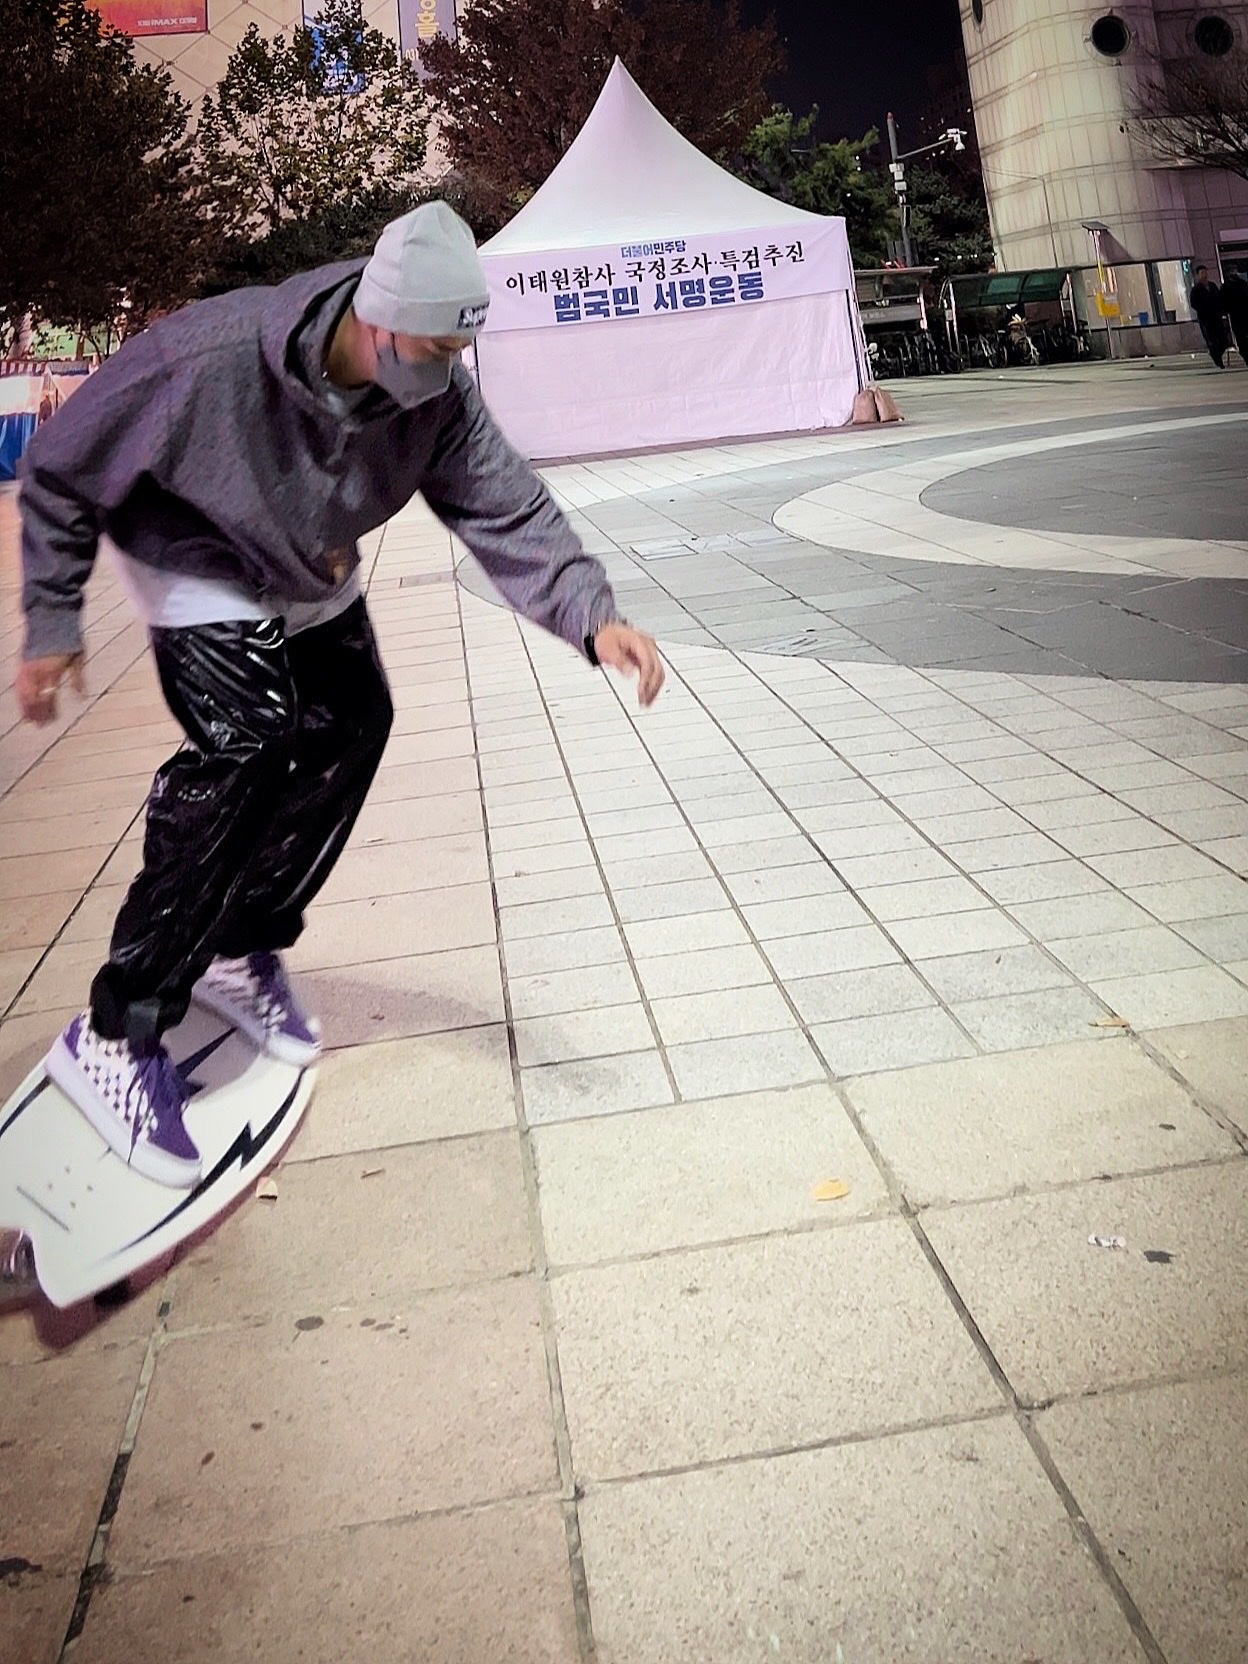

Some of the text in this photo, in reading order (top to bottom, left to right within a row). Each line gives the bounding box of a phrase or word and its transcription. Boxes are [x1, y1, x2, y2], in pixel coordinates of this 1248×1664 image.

[151, 18, 178, 26] IMAX
[620, 240, 687, 258] 더불어민주당
[506, 263, 616, 296] 이태원참사
[553, 271, 764, 323] 범국민 서명운동
